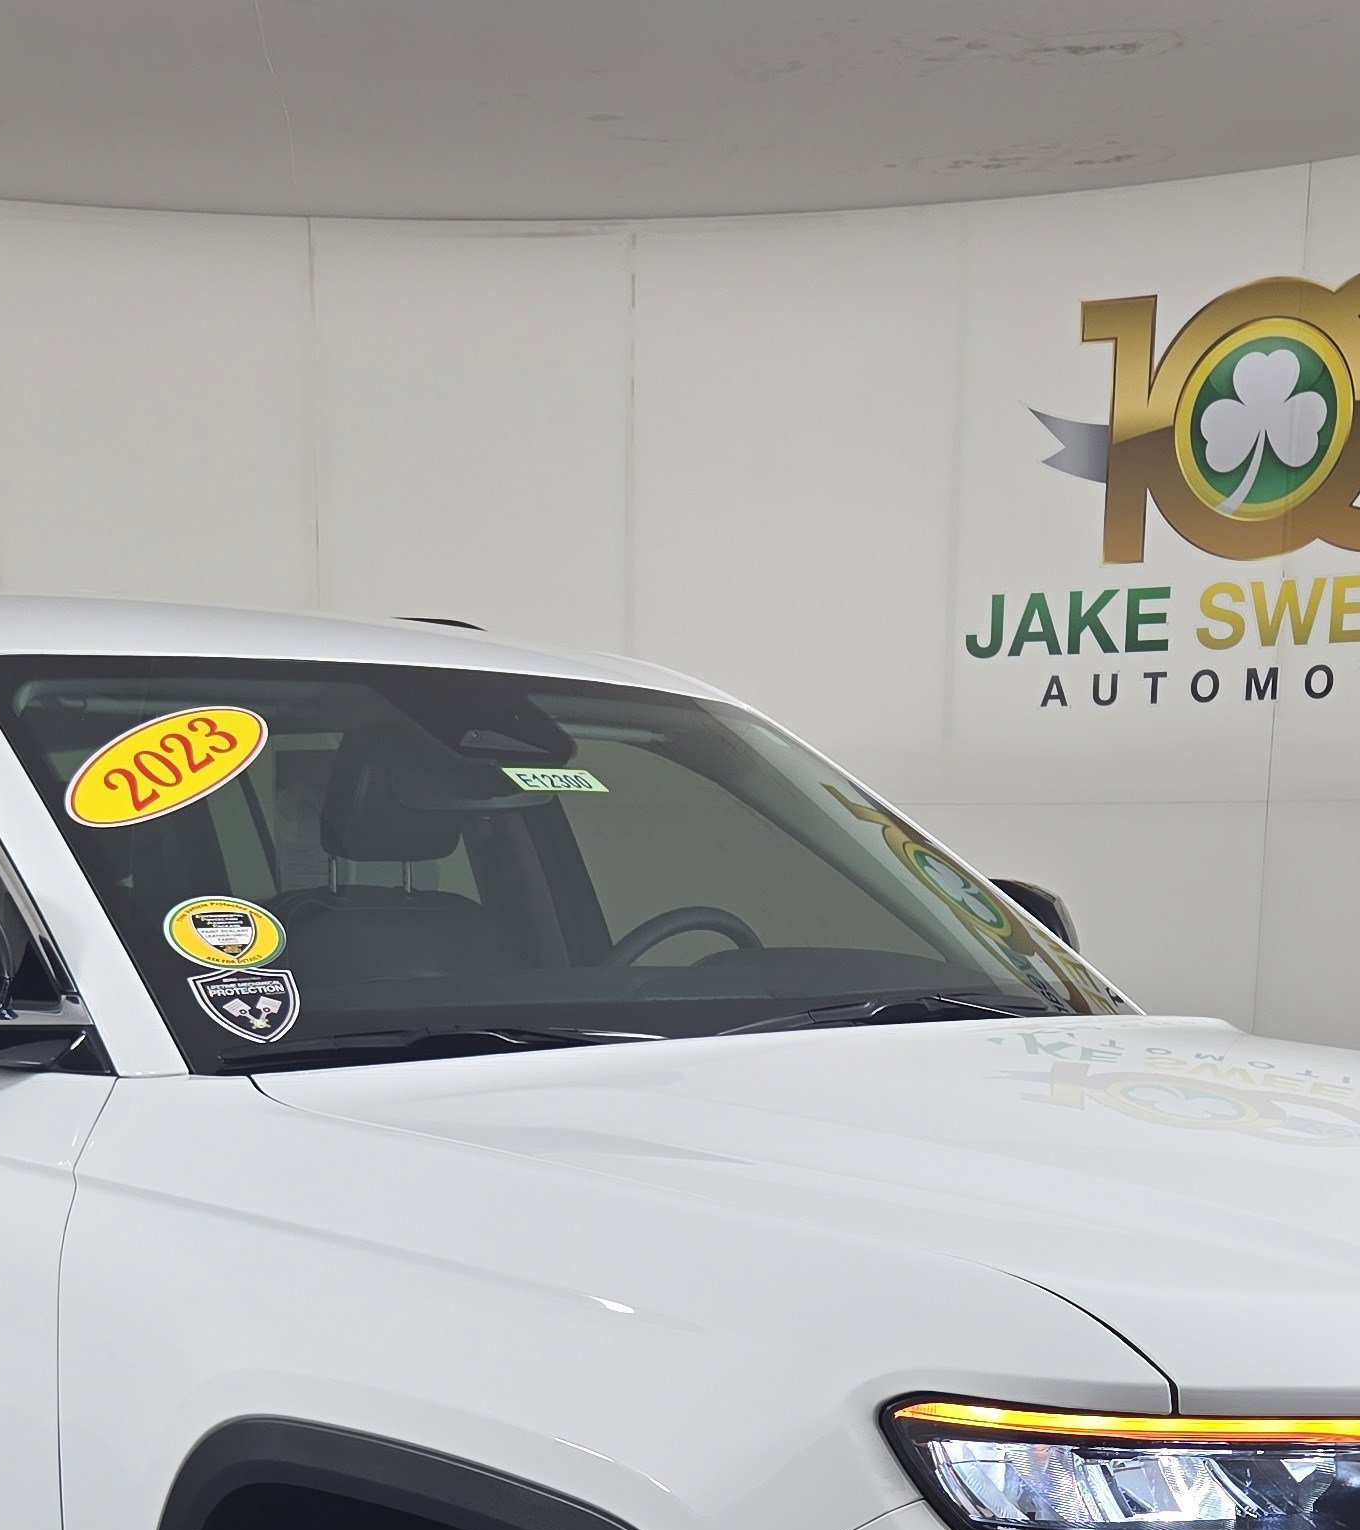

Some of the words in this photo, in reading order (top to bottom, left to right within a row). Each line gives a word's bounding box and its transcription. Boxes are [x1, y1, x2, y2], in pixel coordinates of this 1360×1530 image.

[964, 586, 1171, 658] JAKE
[104, 716, 239, 811] 2023
[516, 773, 593, 789] E12300
[208, 983, 285, 997] PROTECTION
